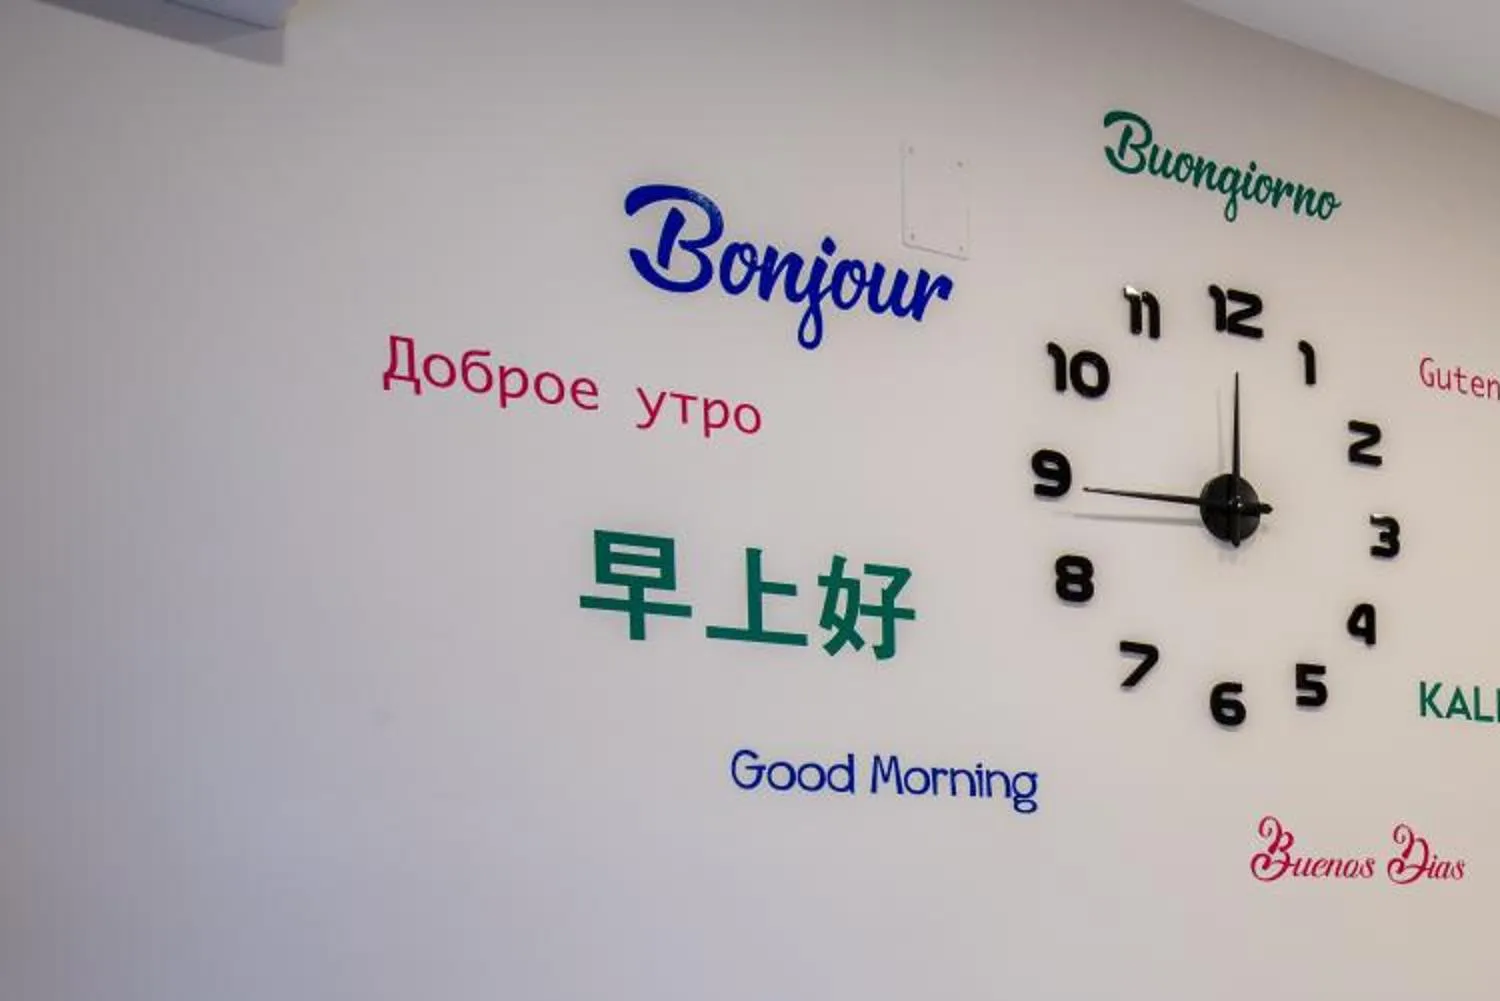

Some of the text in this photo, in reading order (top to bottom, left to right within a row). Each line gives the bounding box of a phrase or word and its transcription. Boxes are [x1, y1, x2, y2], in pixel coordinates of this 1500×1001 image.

[1103, 110, 1342, 222] Buongiorno
[624, 184, 953, 350] Bonjour
[1123, 286, 1161, 339] 11
[1209, 284, 1264, 339] 12
[383, 335, 763, 438] Доброе утро
[1046, 342, 1111, 399] 10
[1298, 340, 1317, 386] 1
[1419, 357, 1500, 400] Guten
[1347, 420, 1383, 467] 2
[1031, 449, 1073, 498] 9
[1369, 514, 1401, 559] 3
[579, 529, 916, 661] 早上好
[1054, 554, 1095, 604] 8
[1346, 603, 1377, 646] 4
[1119, 641, 1160, 688] 7
[1295, 663, 1329, 708] 5
[1209, 682, 1247, 727] 6
[731, 749, 1039, 814] Good Morning
[1250, 816, 1466, 884] Buenos Dias
